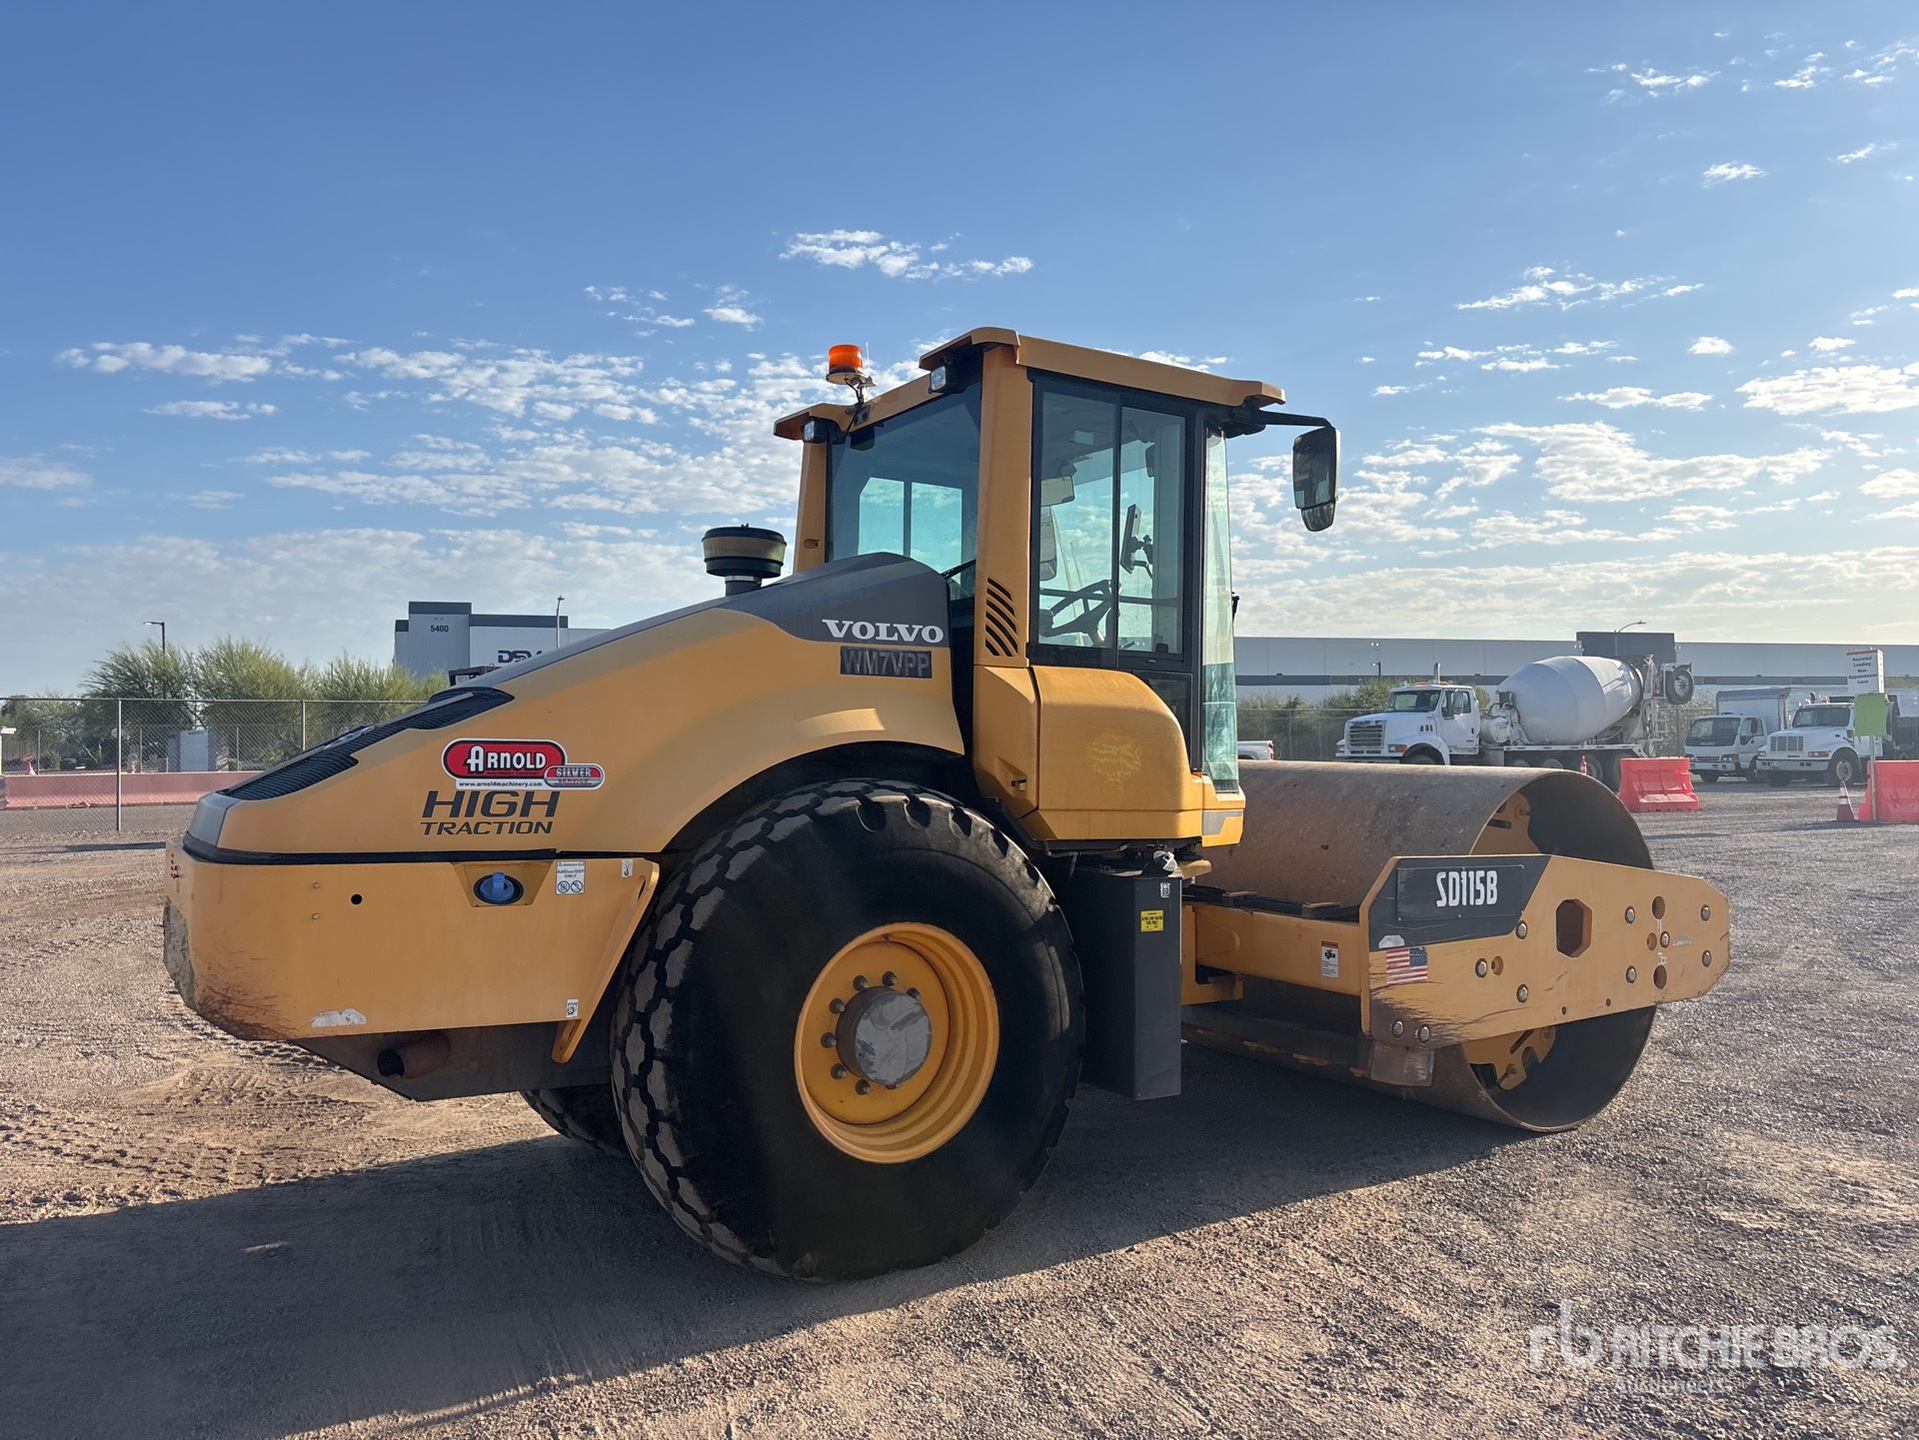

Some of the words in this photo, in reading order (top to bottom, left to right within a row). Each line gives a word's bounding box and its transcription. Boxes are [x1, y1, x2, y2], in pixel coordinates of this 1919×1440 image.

[430, 624, 449, 633] 5400
[822, 619, 944, 643] VOLVO
[555, 767, 592, 777] SILVER
[422, 791, 560, 818] HIGH
[420, 821, 553, 835] TRACTION
[1436, 870, 1498, 907] SD115B
